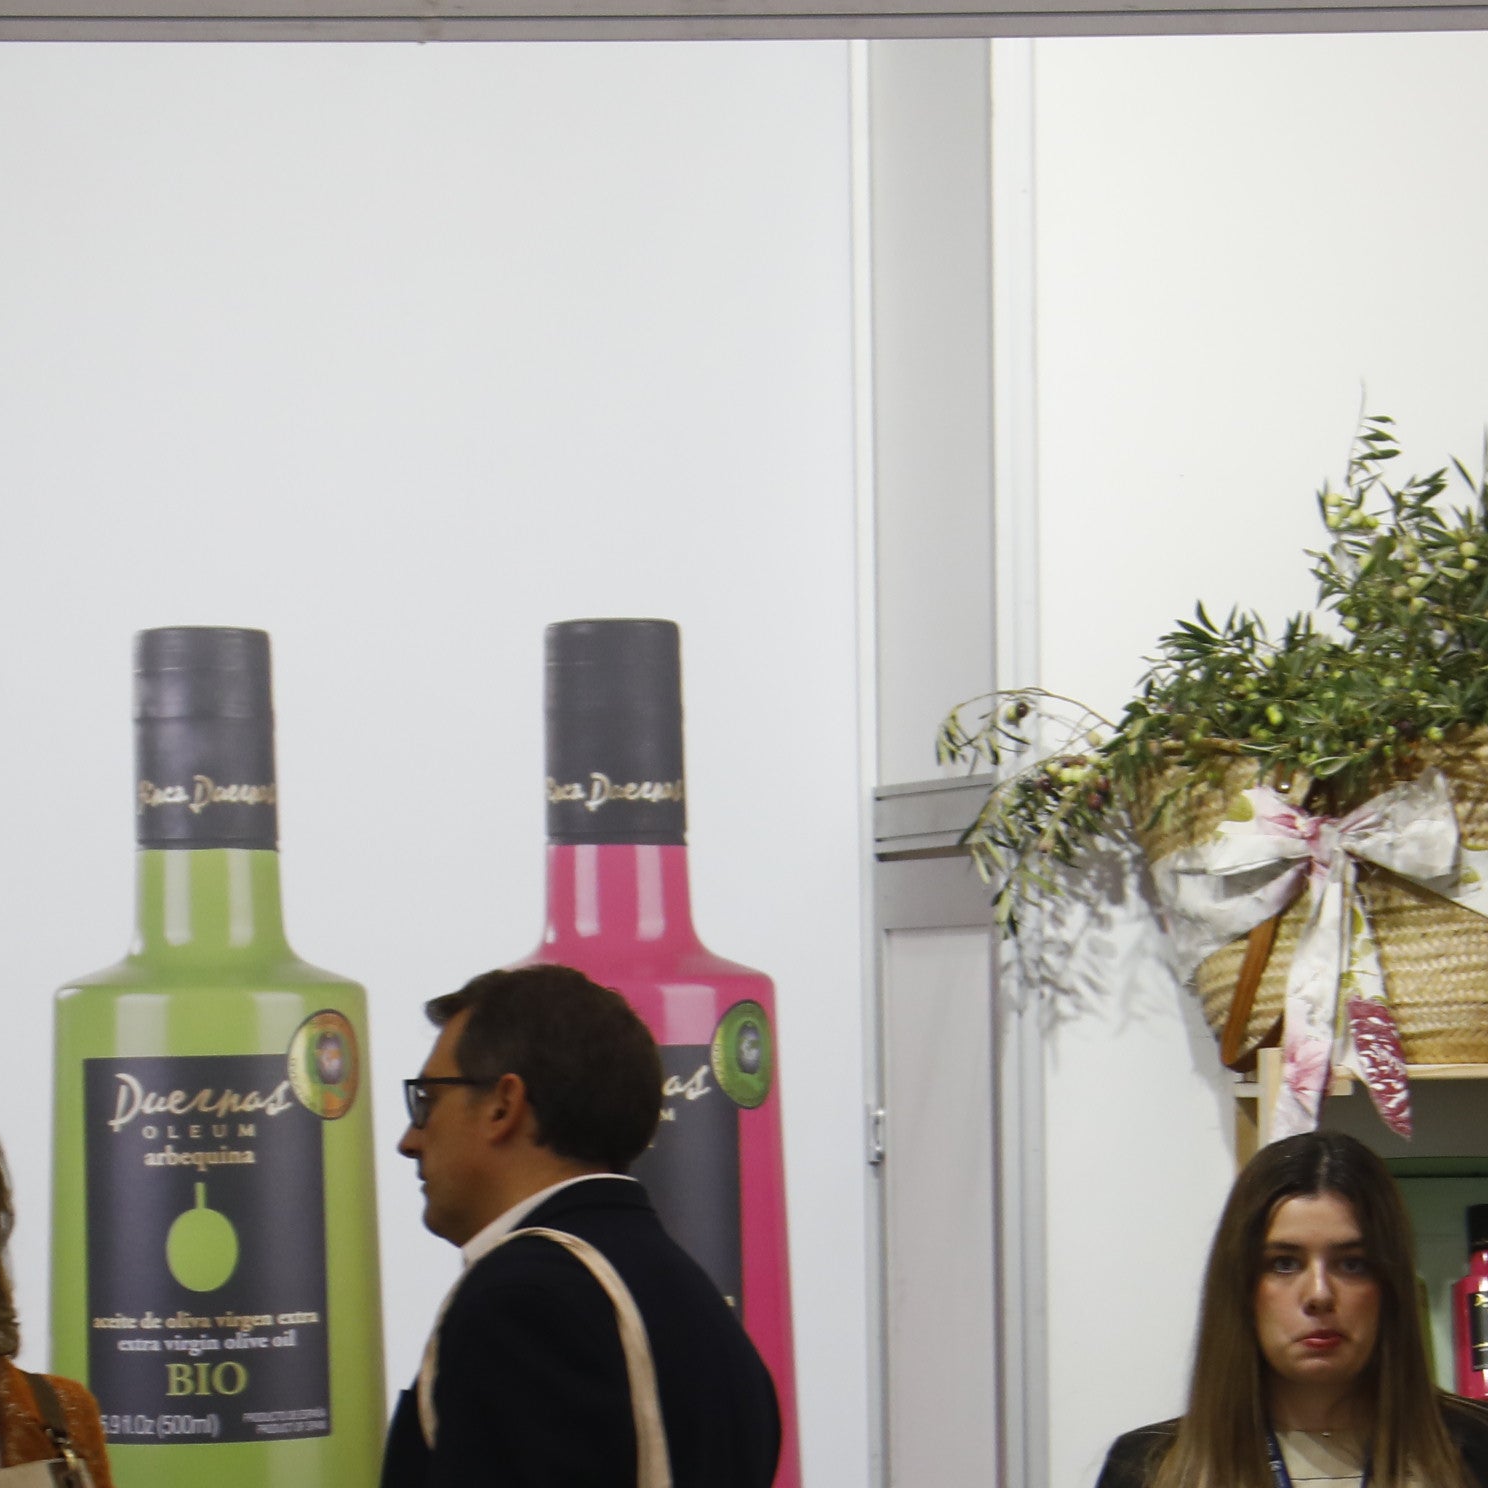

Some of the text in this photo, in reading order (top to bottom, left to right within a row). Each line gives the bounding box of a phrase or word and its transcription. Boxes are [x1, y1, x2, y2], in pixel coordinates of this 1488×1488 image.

[108, 1072, 295, 1132] Duernas
[141, 1123, 257, 1140] OLEUM
[143, 1146, 256, 1172] arbequina
[163, 1335, 220, 1356] virgin
[223, 1332, 269, 1350] olive
[271, 1329, 297, 1348] oil
[165, 1361, 250, 1396] BIO
